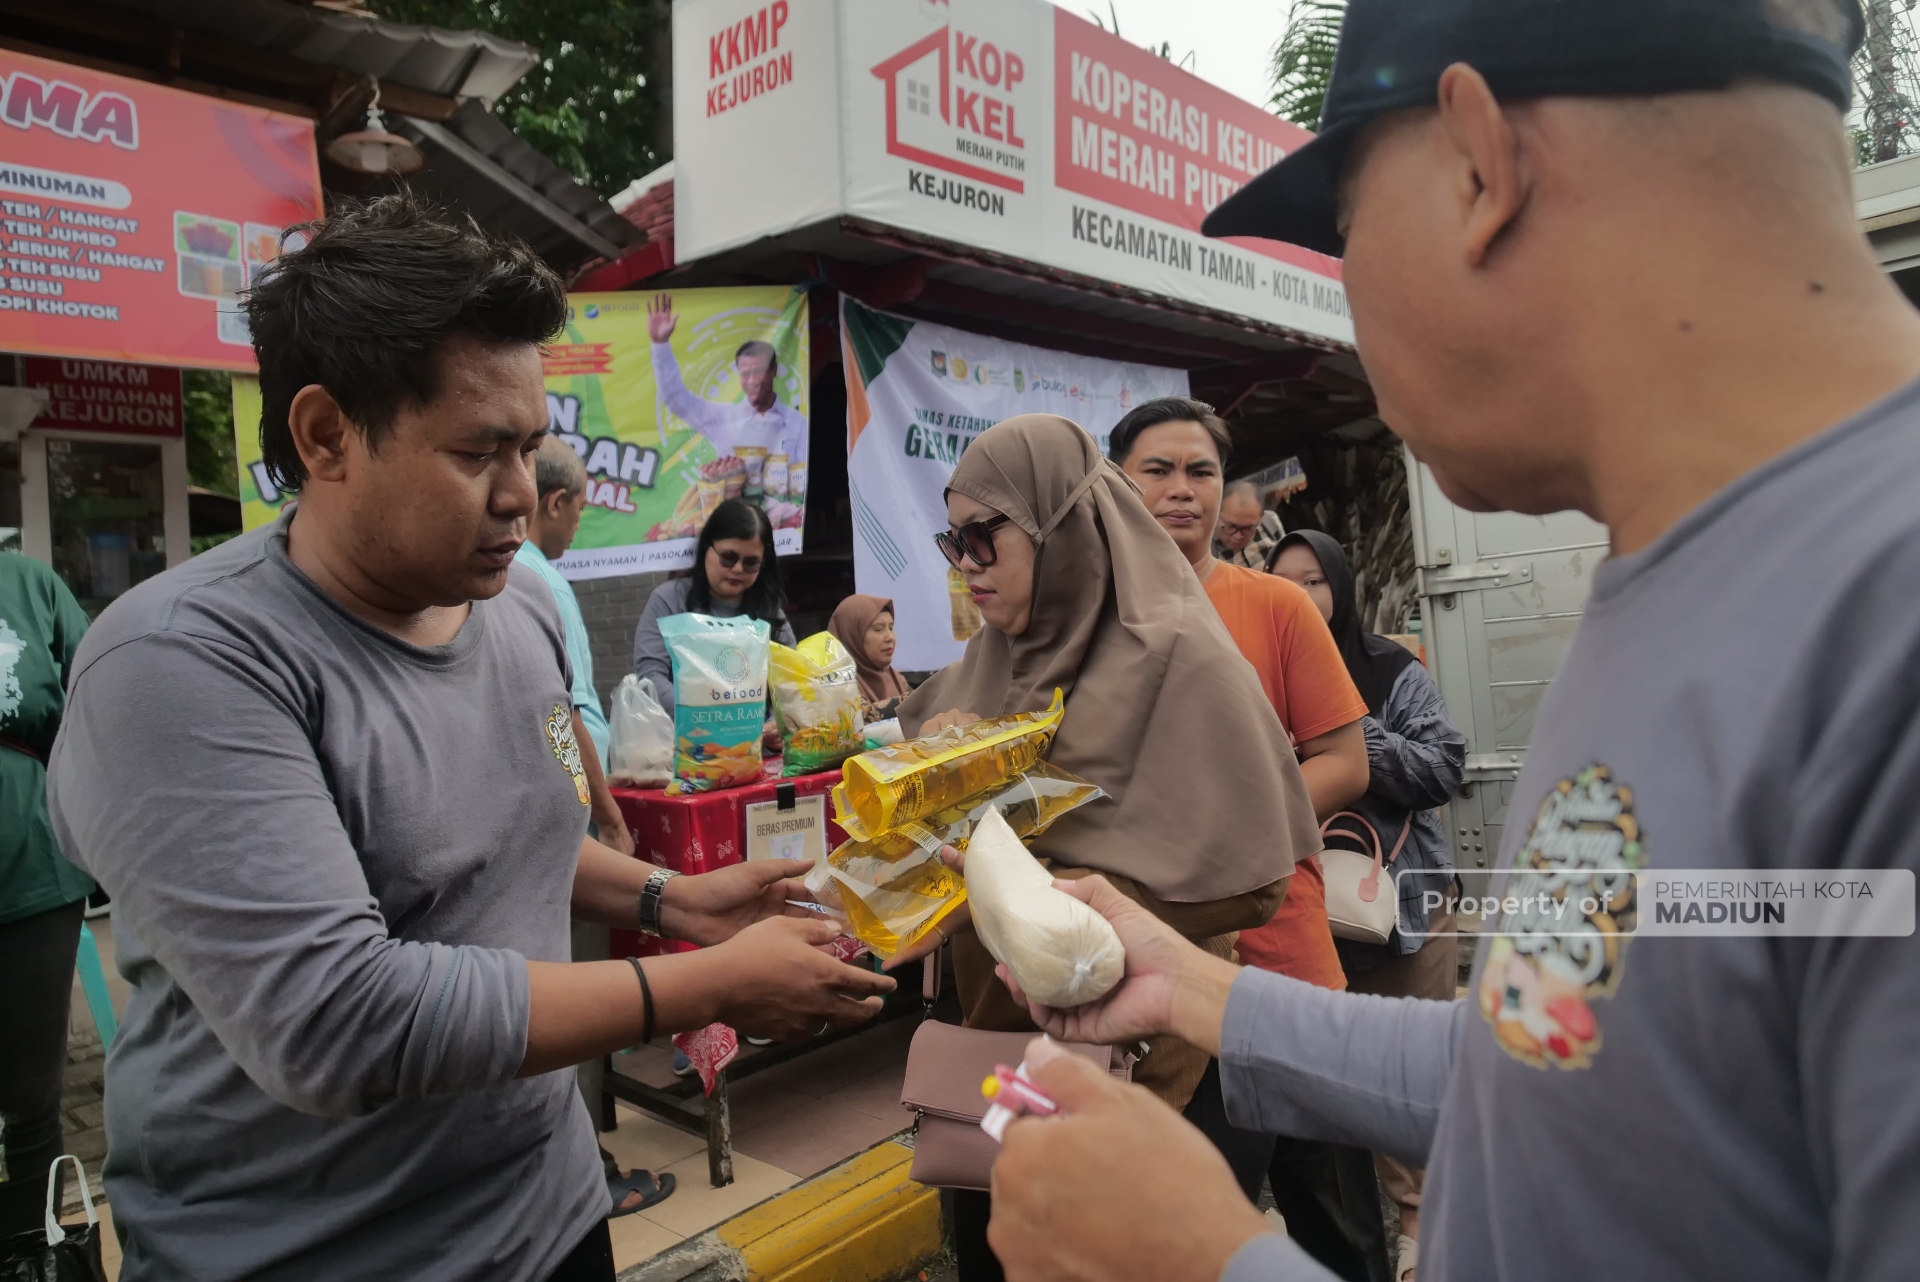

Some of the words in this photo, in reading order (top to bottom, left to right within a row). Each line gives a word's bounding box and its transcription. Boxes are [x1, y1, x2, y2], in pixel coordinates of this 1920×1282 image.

[708, 0, 789, 79] KKMP
[955, 30, 1025, 93] KOP
[706, 51, 793, 119] KEJURON
[0, 71, 139, 150] MA
[956, 86, 1025, 149] KEL
[1071, 51, 1208, 156] KOPERASI
[956, 138, 993, 162] MERAH
[995, 150, 1025, 171] PUTIH
[1071, 115, 1175, 200] MERAH
[1184, 162, 1246, 213] PUT
[908, 169, 1005, 216] KEJURON
[2, 200, 41, 219] TEH
[59, 208, 139, 234] HANGAT
[4, 219, 43, 238] TEH
[47, 226, 118, 248] JUMBO
[7, 239, 71, 261] JERUK
[88, 250, 165, 273] HANGAT
[8, 257, 47, 276] TEH
[50, 263, 102, 283] SUSU
[1072, 205, 1192, 272] KECAMATAN
[1199, 246, 1255, 290] TAMAN
[1273, 269, 1308, 306] KOTA
[10, 276, 63, 297] SUSU
[36, 298, 121, 321] KHOTOK
[61, 359, 149, 386] UMKM
[36, 382, 174, 408] ELURAHAN
[556, 559, 591, 570] PUASA
[592, 556, 637, 567] NYAMAN
[648, 549, 694, 561] PASOKAN
[711, 687, 762, 700] befood
[691, 710, 734, 723] SETRA
[757, 822, 781, 836] BERAS
[781, 816, 815, 832] PREMIUM
